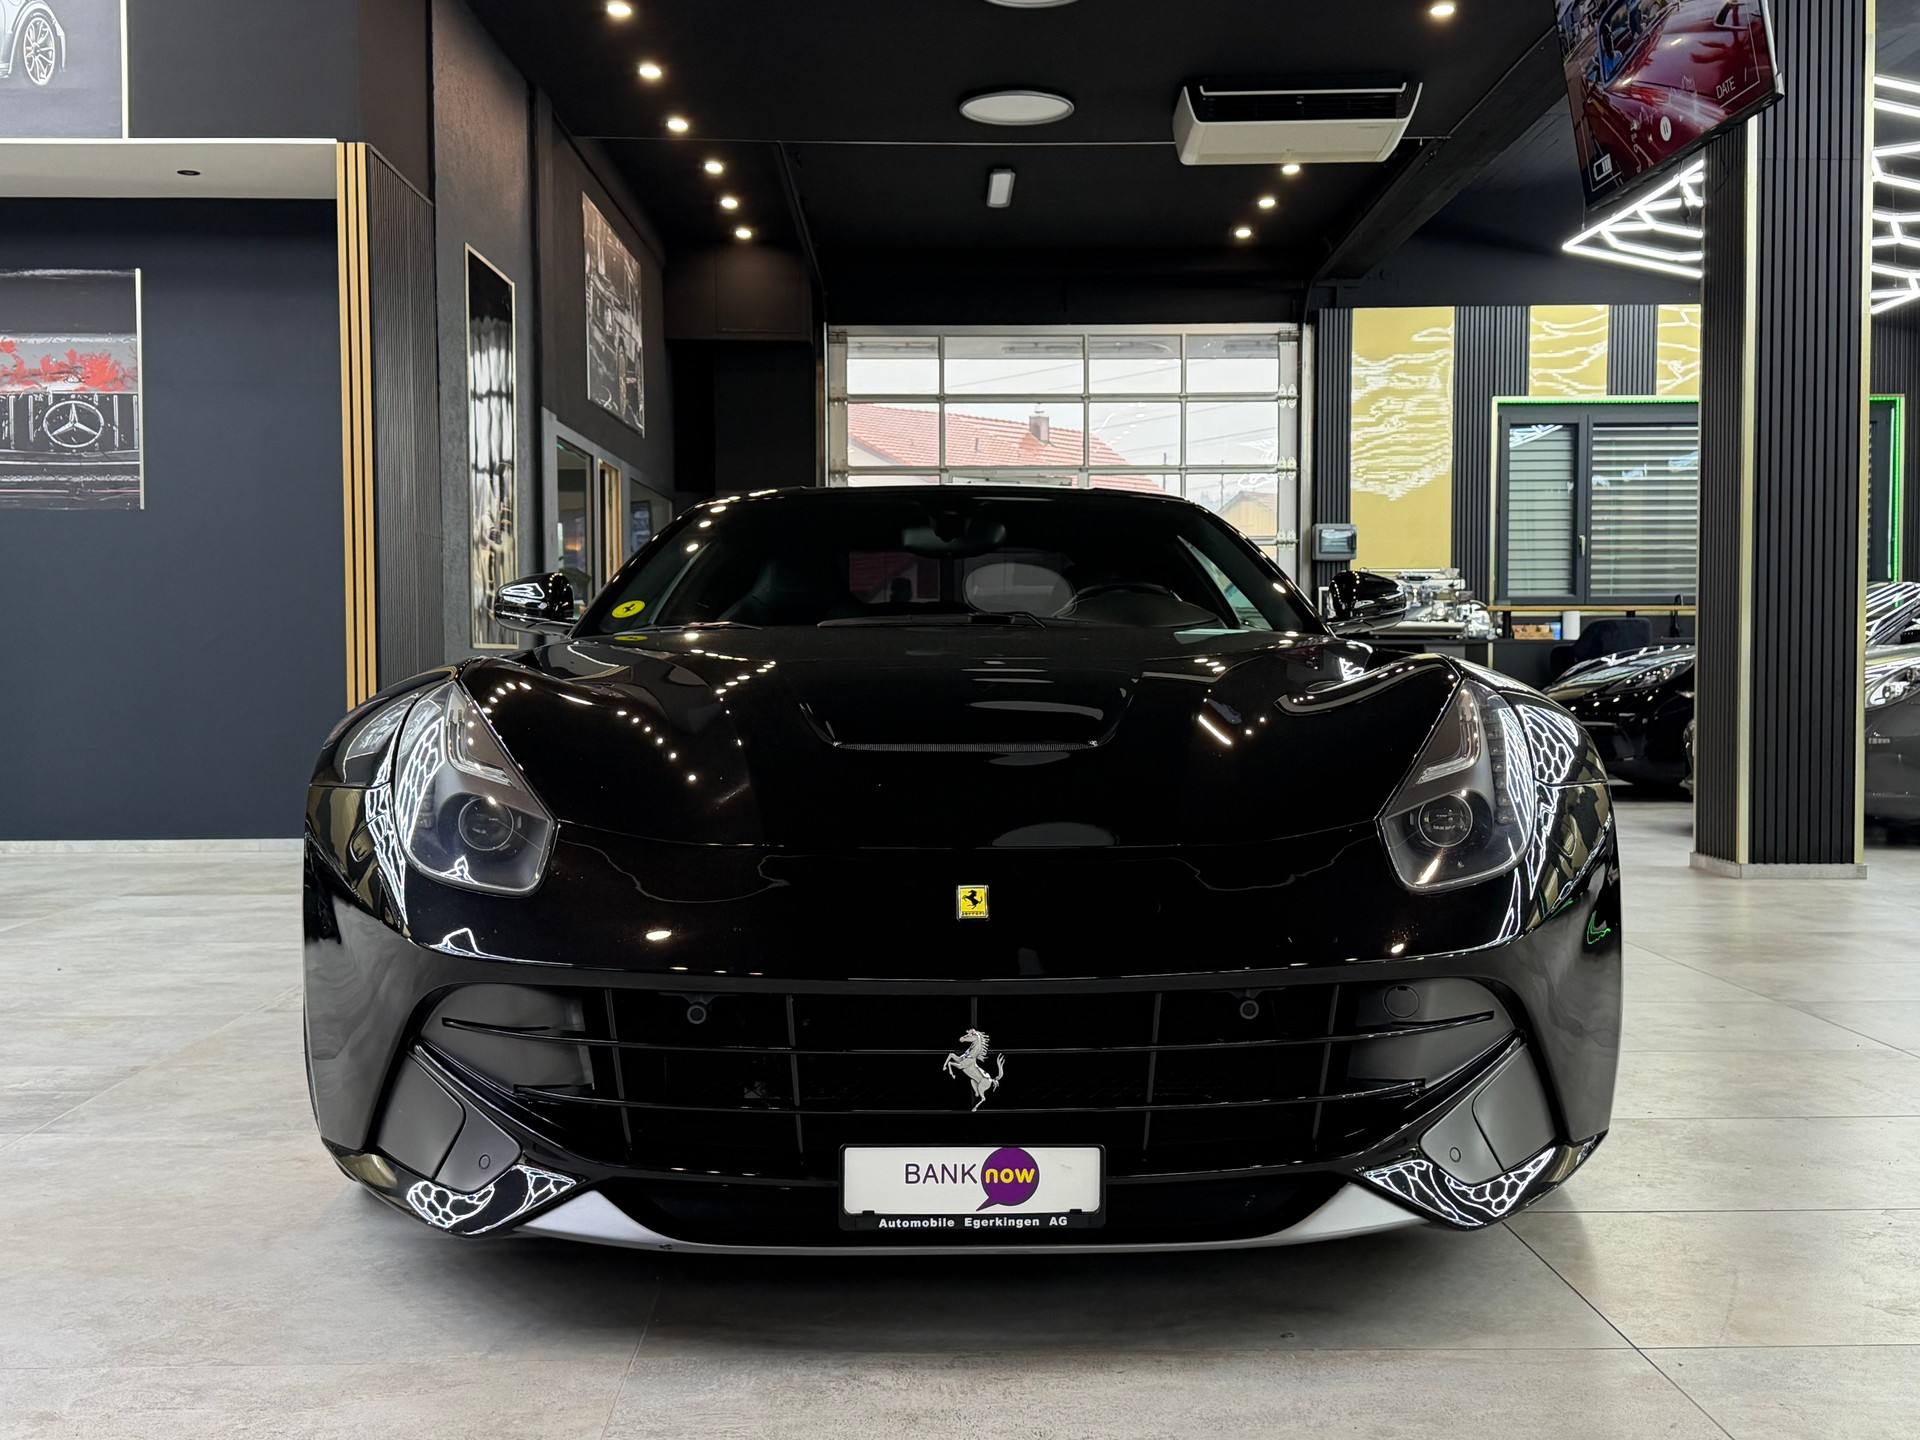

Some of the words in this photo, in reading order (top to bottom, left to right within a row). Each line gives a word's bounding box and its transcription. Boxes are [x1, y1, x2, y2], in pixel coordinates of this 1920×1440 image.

[1716, 76, 1737, 99] DATE
[904, 1163, 978, 1185] BANK
[985, 1166, 1036, 1184] now
[878, 1217, 955, 1228] Automobile
[964, 1216, 1040, 1229] Egerkingen
[1049, 1216, 1068, 1226] AG
